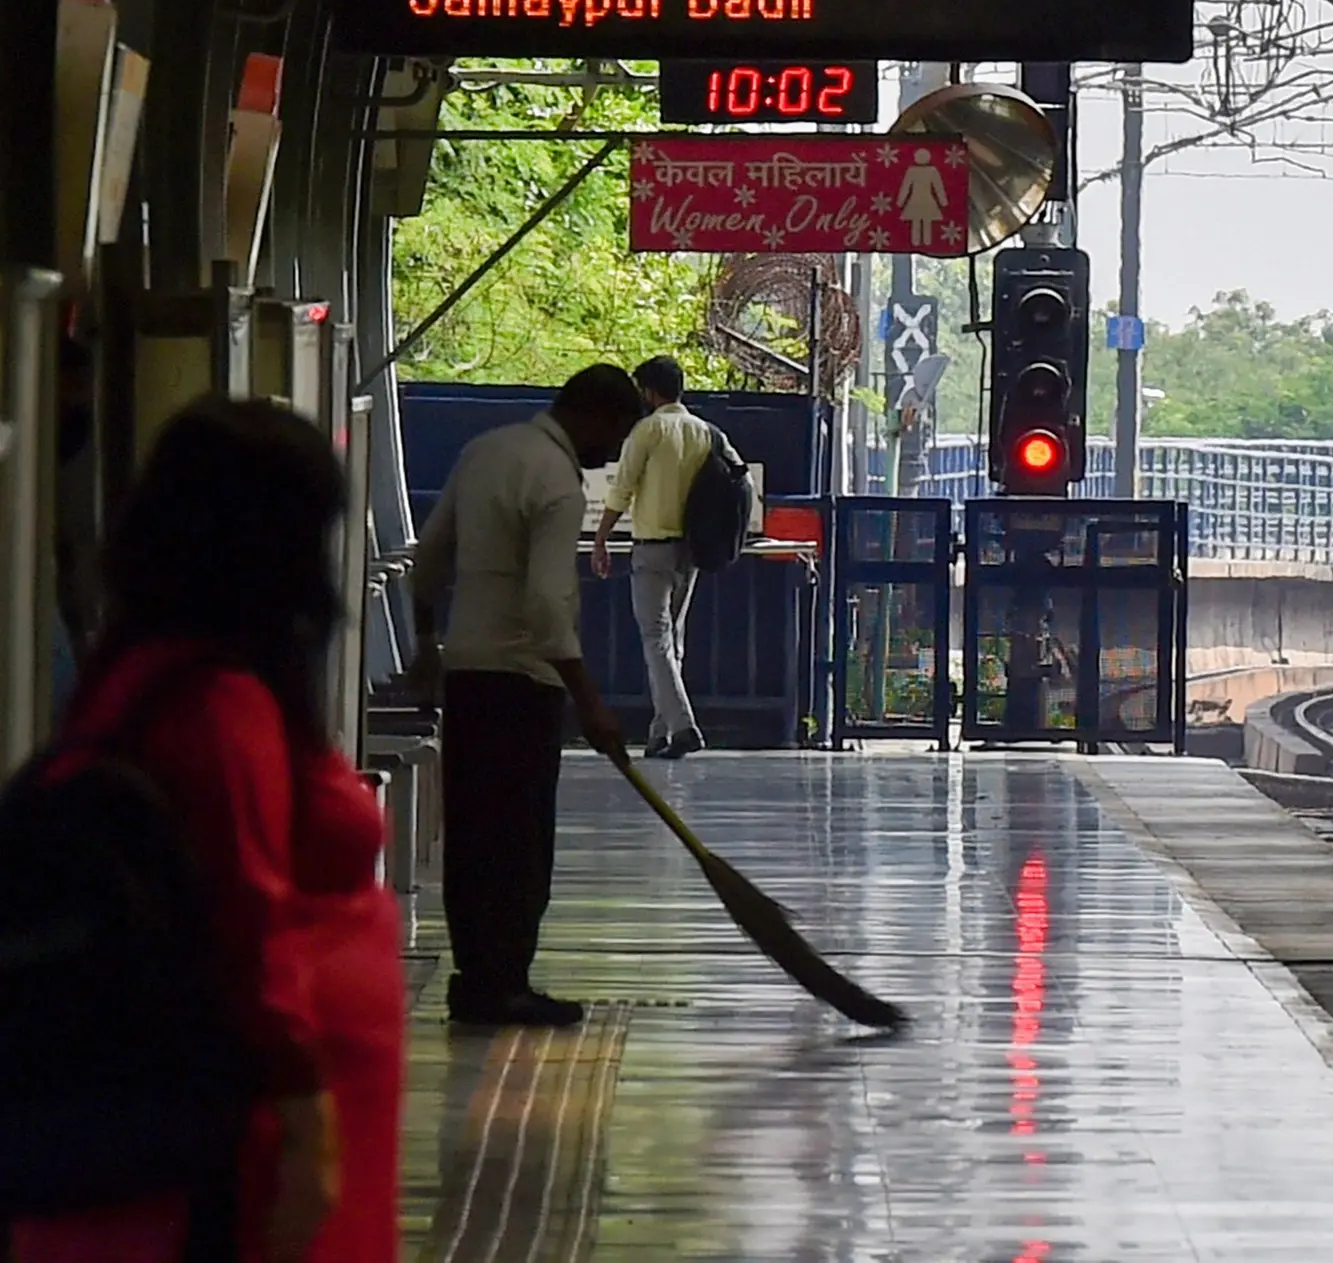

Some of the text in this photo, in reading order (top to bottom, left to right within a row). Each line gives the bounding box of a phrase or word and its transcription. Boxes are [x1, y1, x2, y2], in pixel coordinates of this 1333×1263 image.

[708, 66, 854, 114] 10:02
[653, 150, 734, 187] केवल
[650, 194, 871, 247] Women Only
